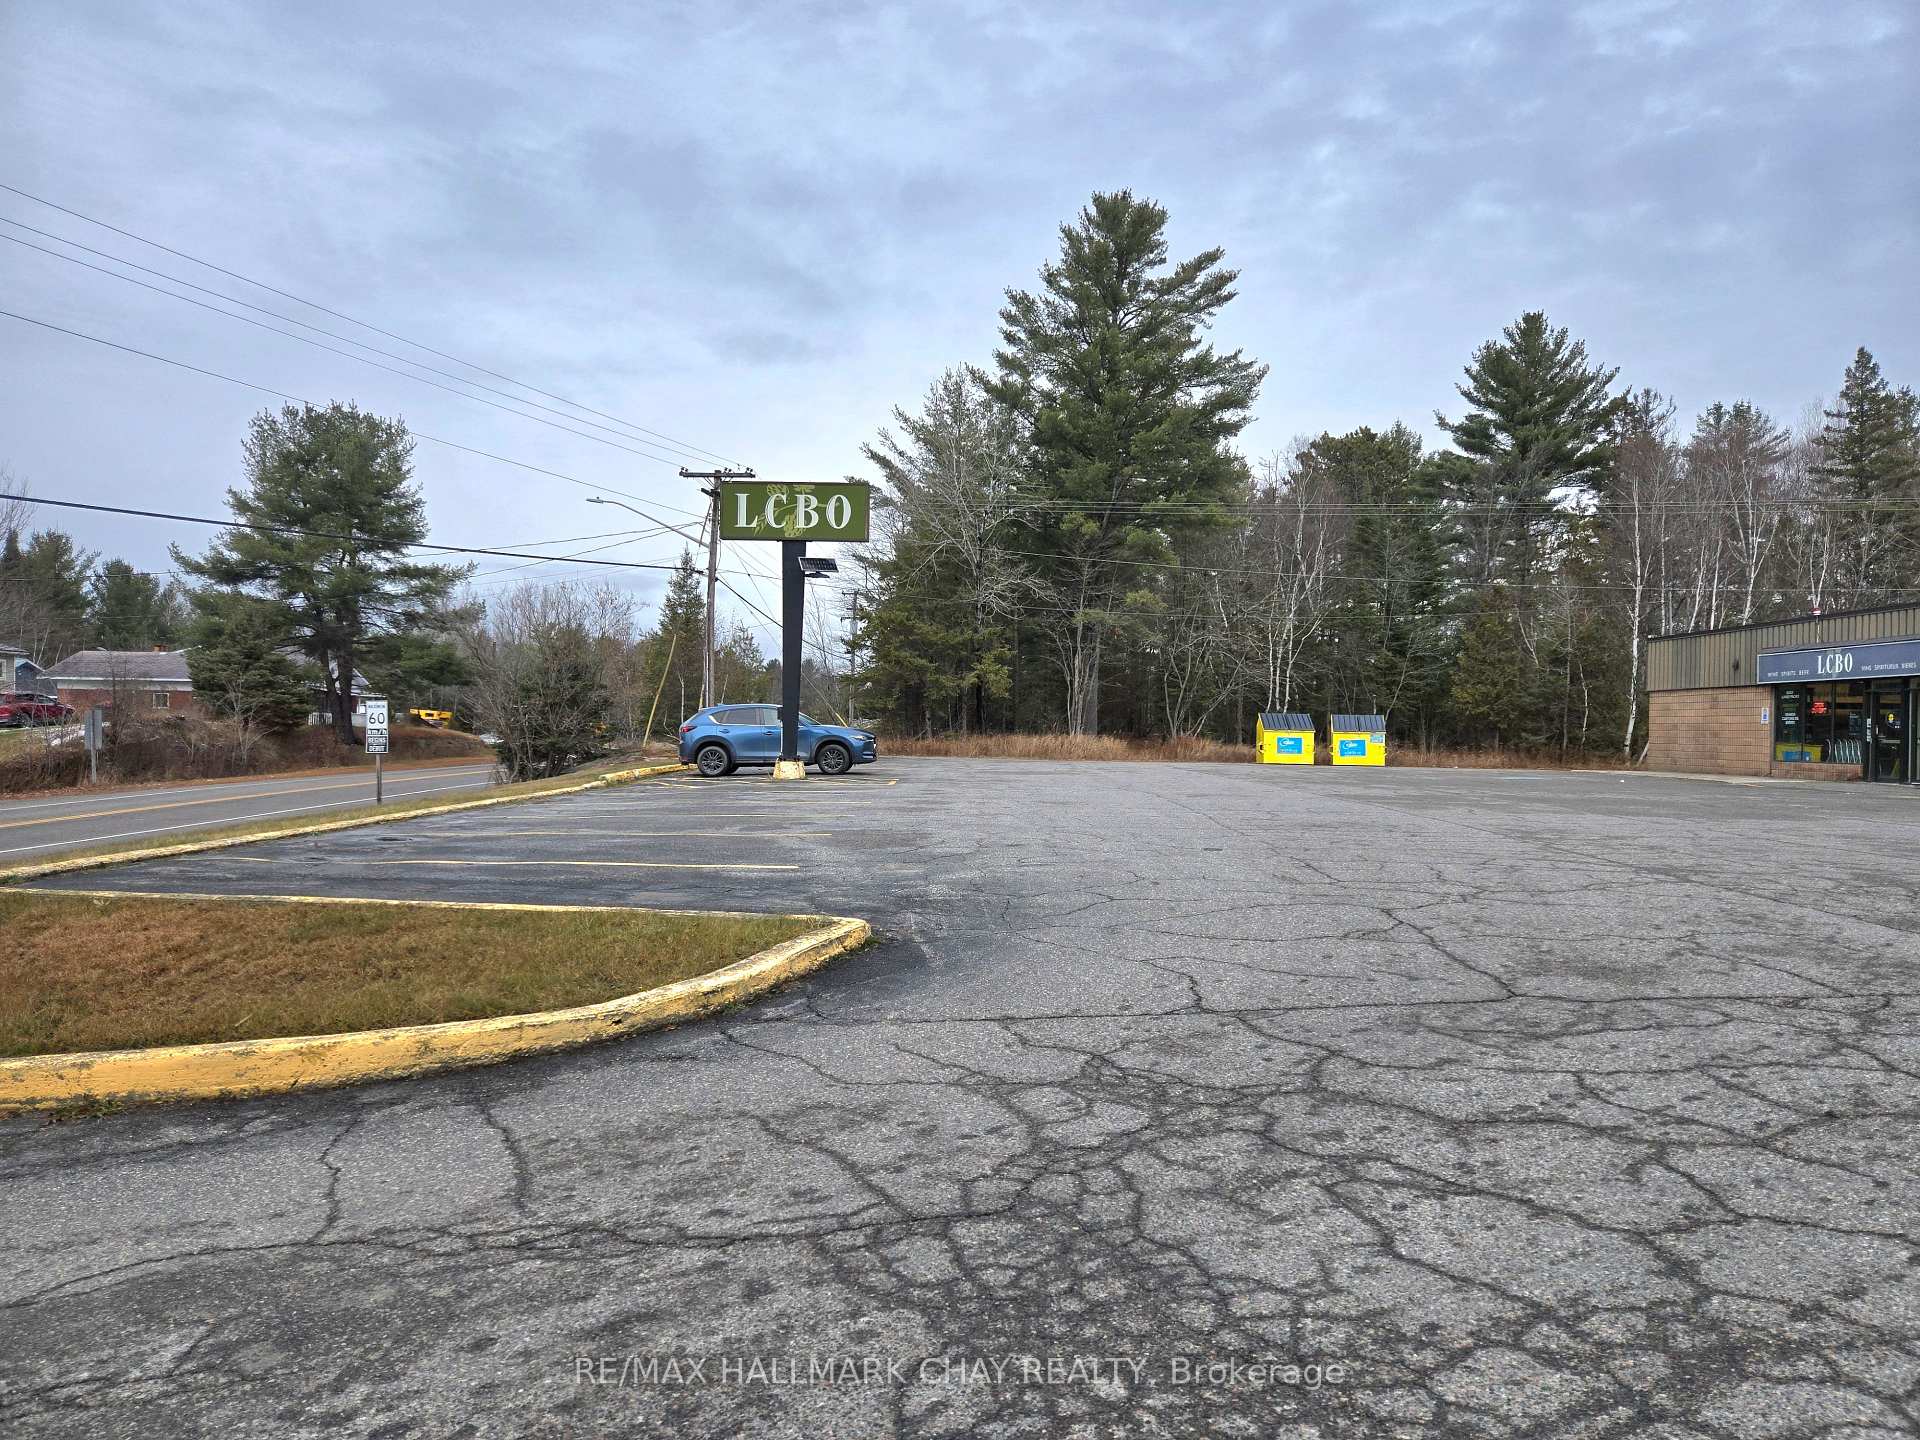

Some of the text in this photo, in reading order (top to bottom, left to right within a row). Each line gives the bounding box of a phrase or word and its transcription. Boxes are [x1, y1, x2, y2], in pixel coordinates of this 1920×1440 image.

[735, 493, 851, 529] LCBO
[1817, 653, 1853, 674] LCBO
[368, 712, 385, 724] 60
